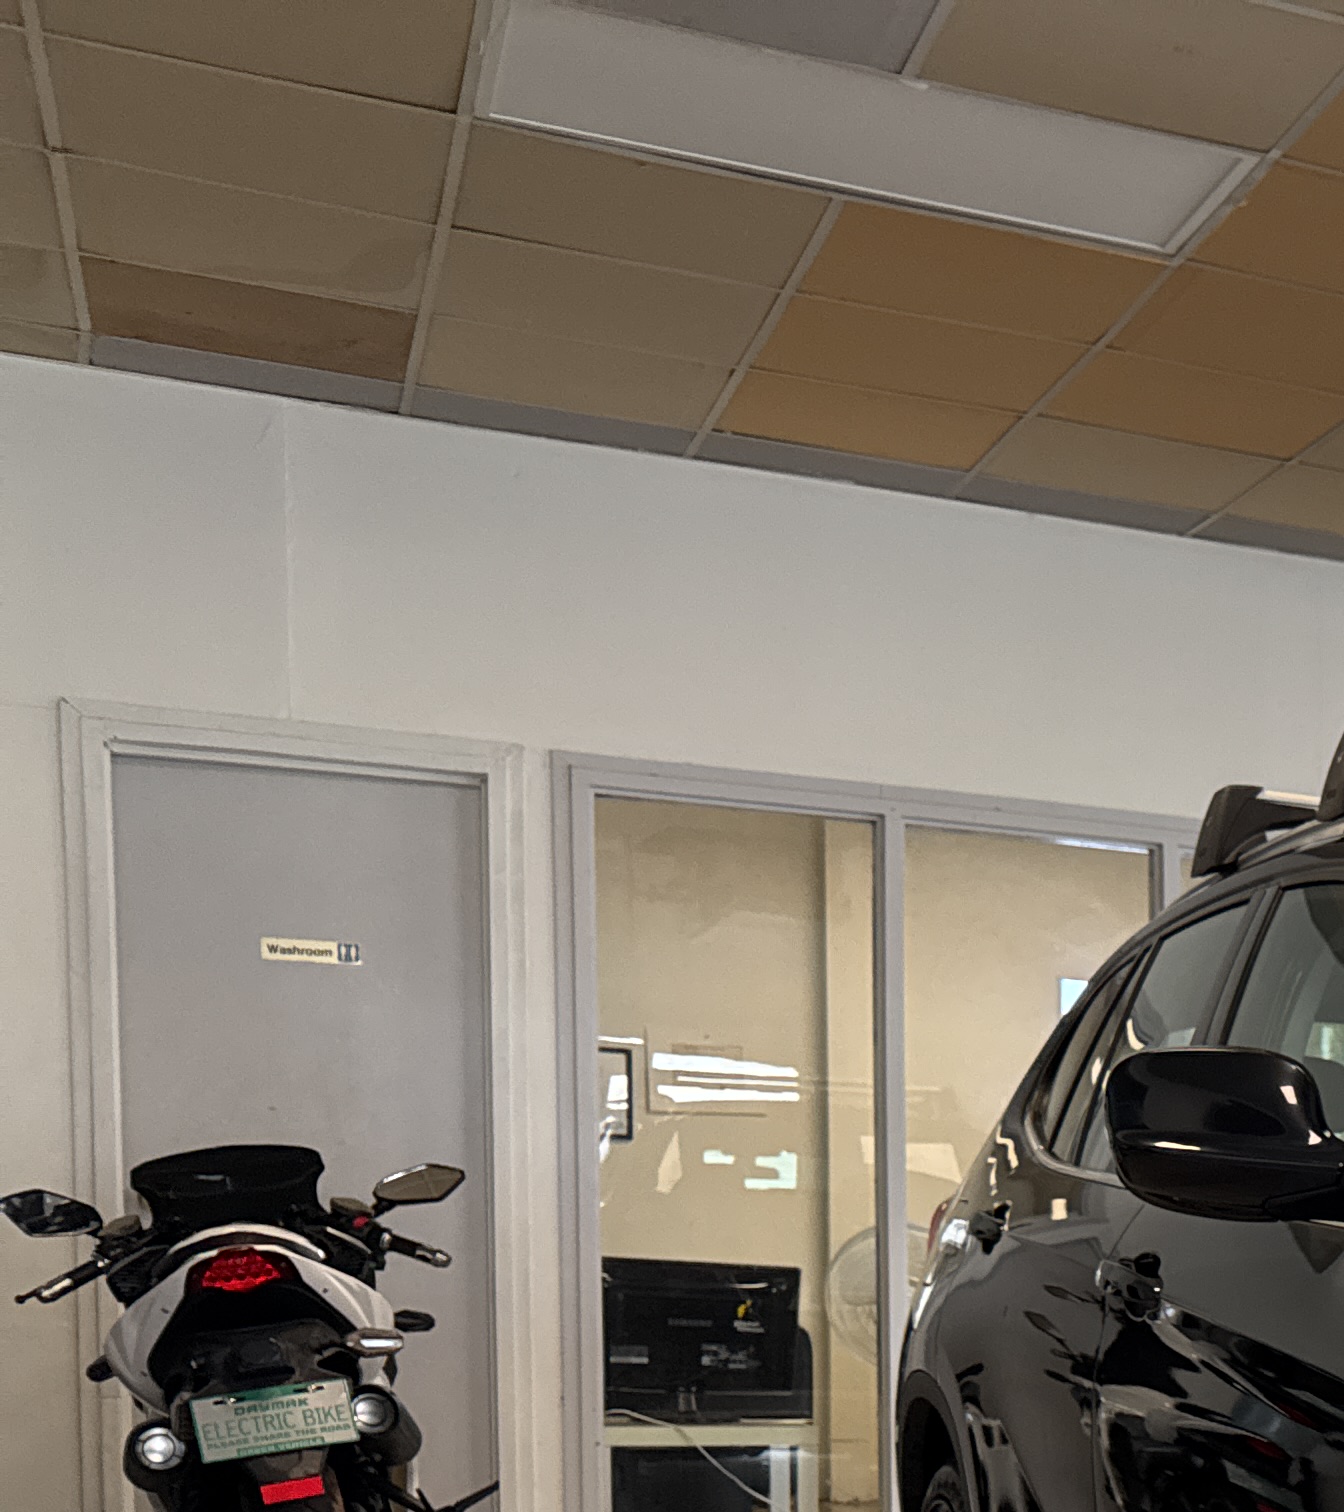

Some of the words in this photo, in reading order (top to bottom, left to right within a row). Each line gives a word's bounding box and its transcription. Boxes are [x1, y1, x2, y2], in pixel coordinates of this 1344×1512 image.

[266, 943, 333, 957] Washroom
[234, 1398, 309, 1416] DAYMAK
[201, 1411, 296, 1441] ELECTRIC
[302, 1404, 350, 1427] BIKE
